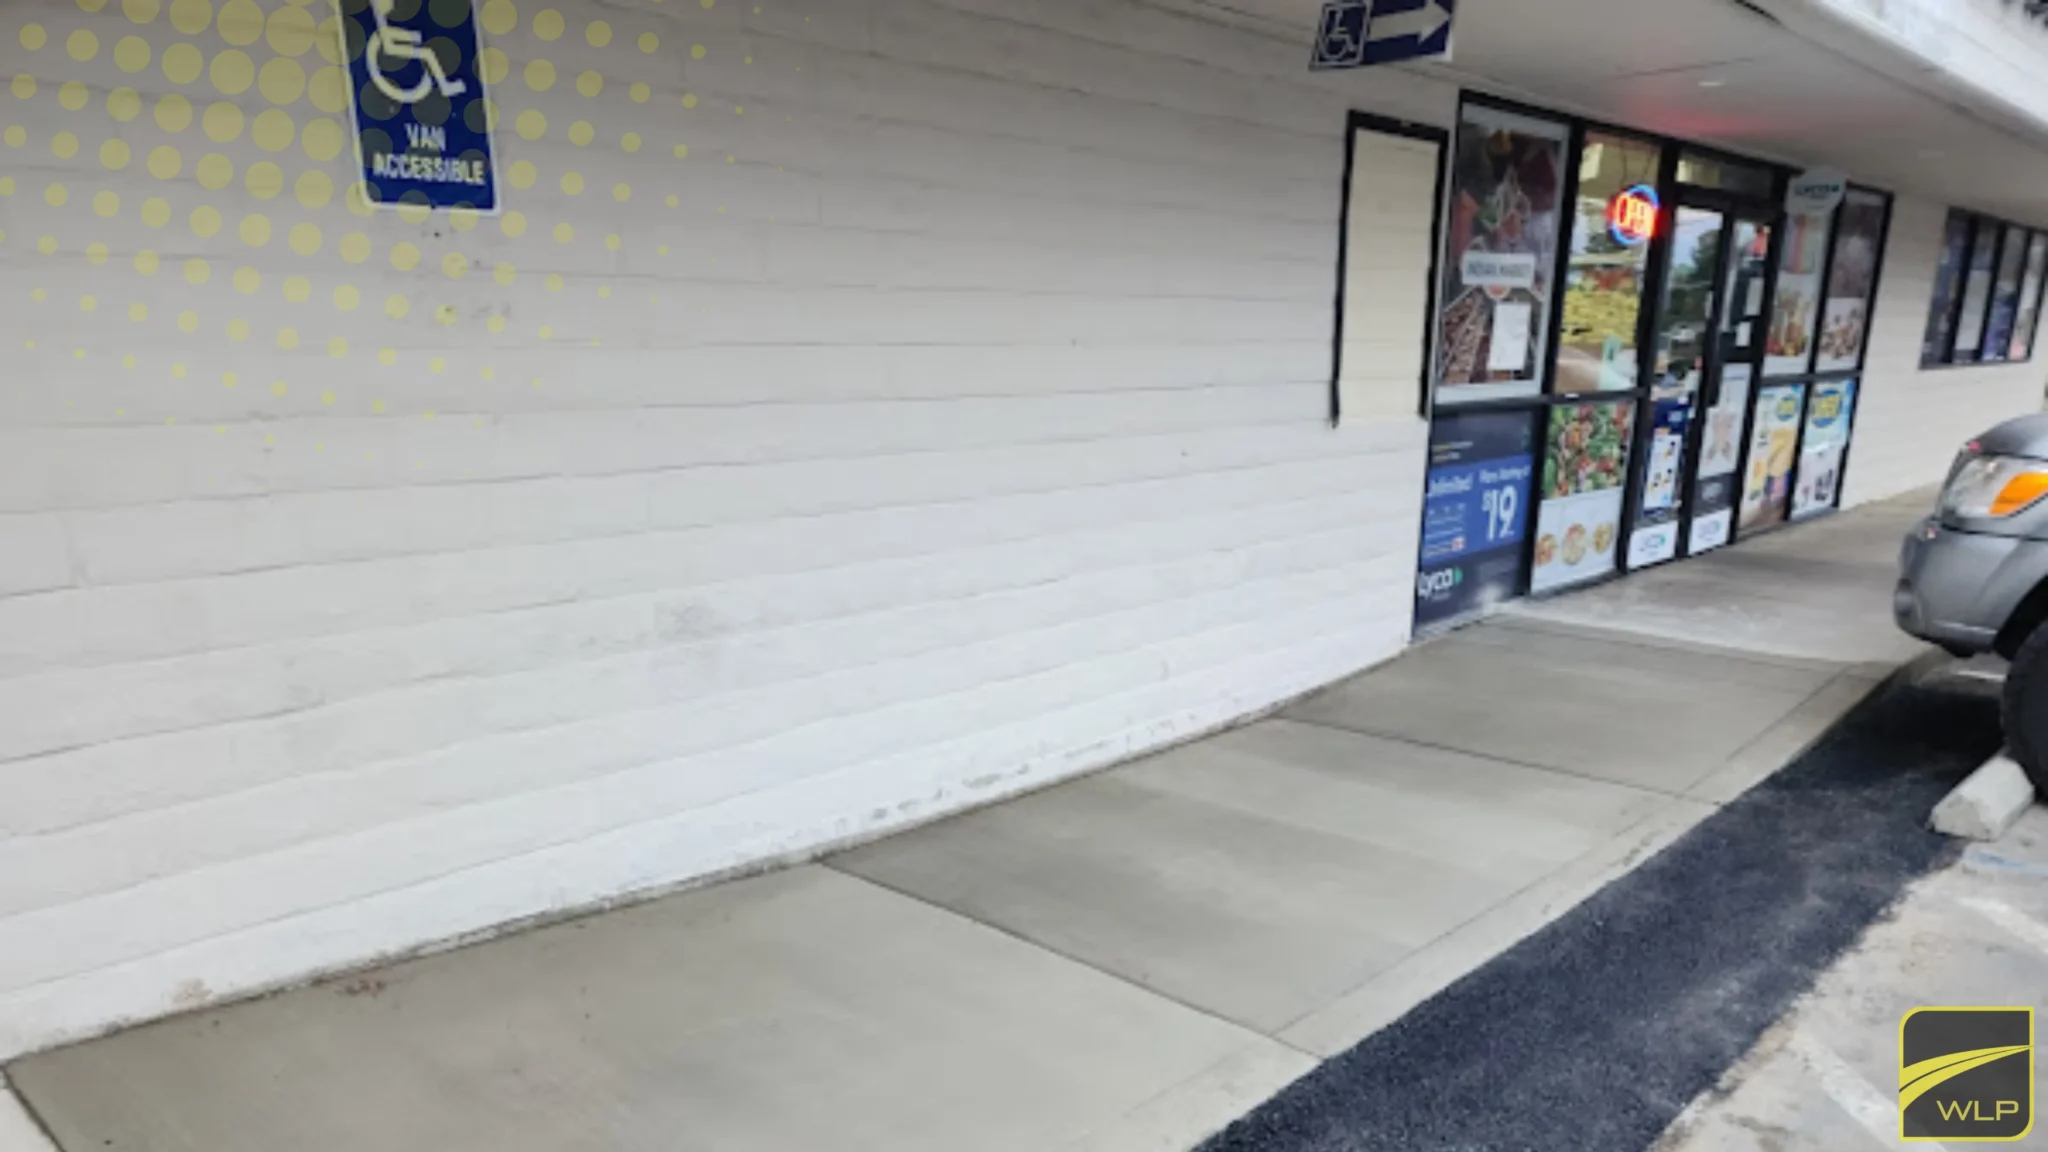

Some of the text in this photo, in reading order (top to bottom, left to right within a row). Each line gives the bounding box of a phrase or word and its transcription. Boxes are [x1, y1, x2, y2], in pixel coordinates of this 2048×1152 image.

[404, 123, 446, 151] VAN
[373, 153, 486, 185] ACCESSIBLE
[1615, 192, 1655, 238] OPEN
